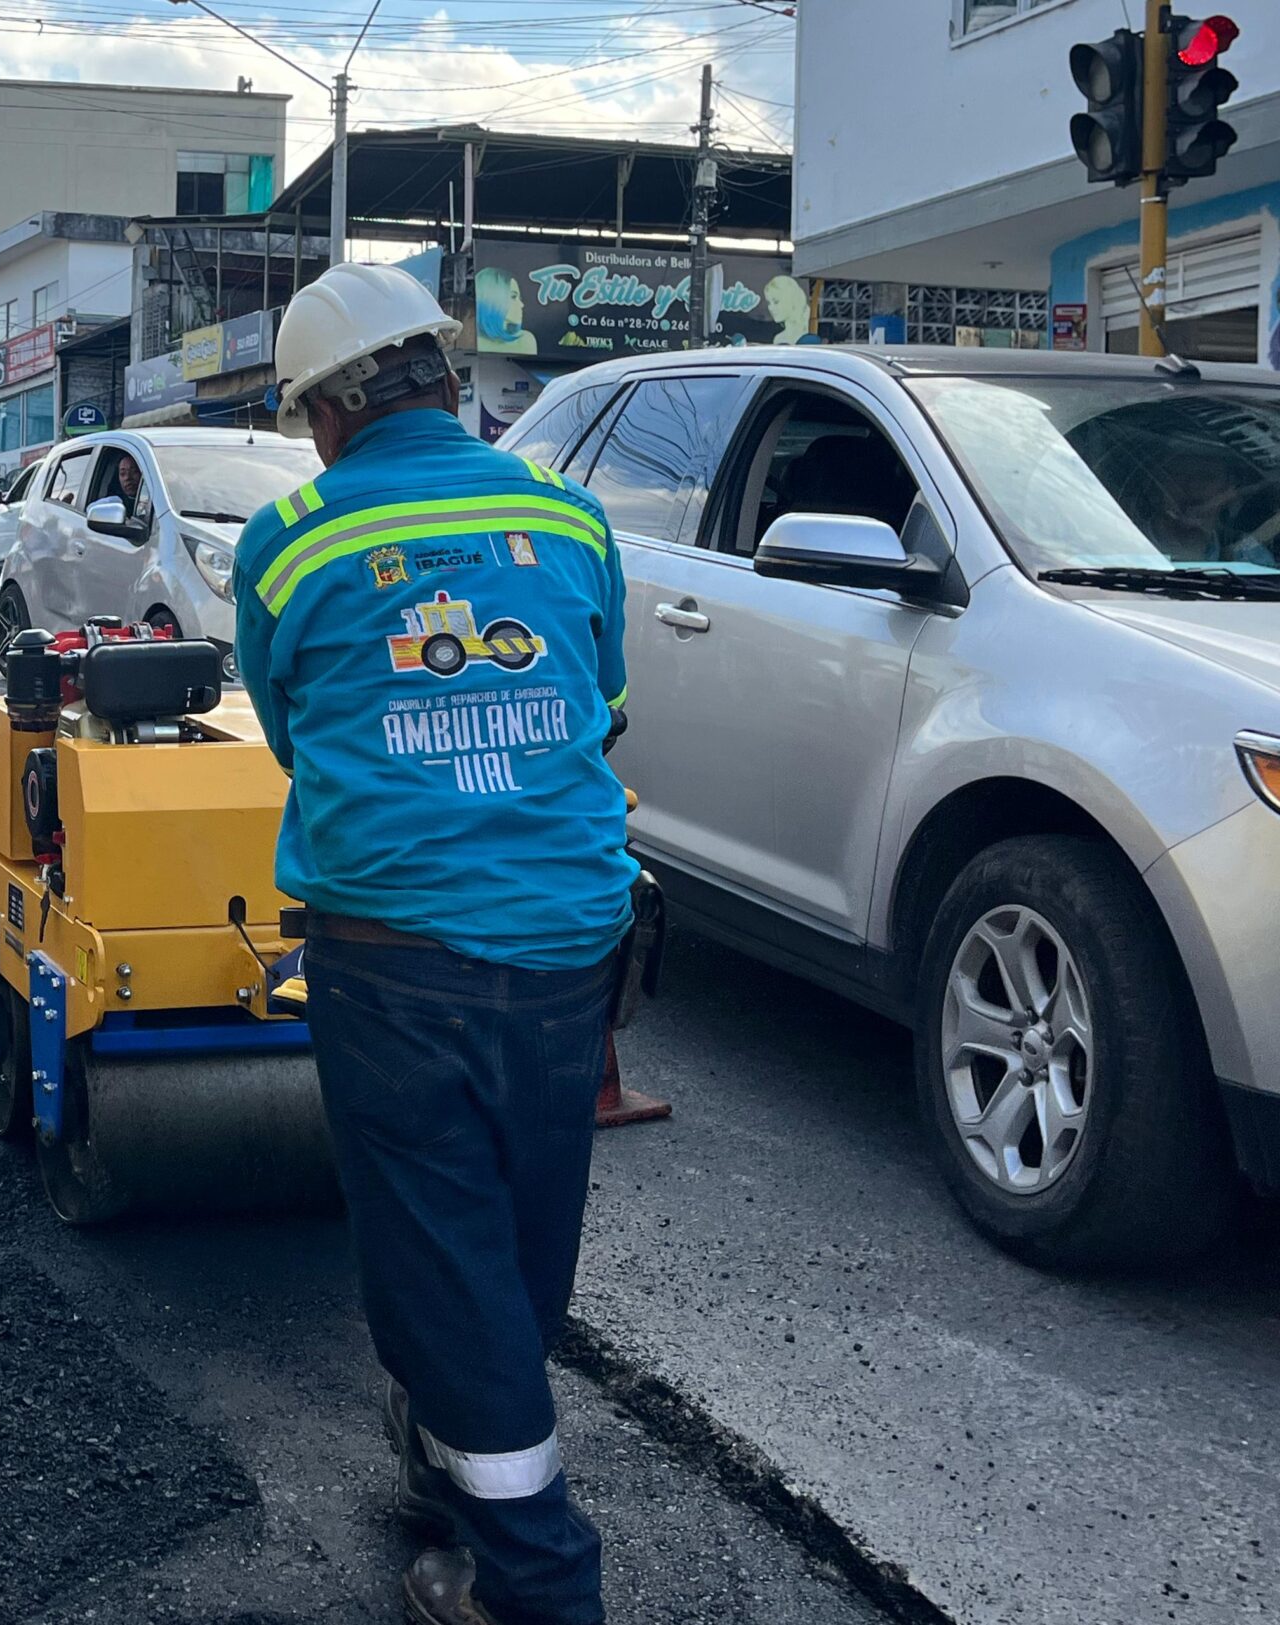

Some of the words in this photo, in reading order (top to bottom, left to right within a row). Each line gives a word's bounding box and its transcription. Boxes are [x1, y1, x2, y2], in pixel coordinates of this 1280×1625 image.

[585, 252, 652, 268] Distribuidora
[654, 257, 668, 268] de
[529, 264, 581, 305] Tu
[573, 266, 654, 308] Estilo
[581, 315, 598, 326] Cra
[600, 315, 616, 327] 6ta
[415, 550, 485, 571] IBAGUÉ
[388, 698, 431, 712] CUADRILLA
[436, 696, 446, 708] DE
[450, 690, 497, 706] REPARCHEO
[501, 689, 511, 700] DE
[514, 686, 558, 700] EMERGENCIA
[382, 699, 570, 755] AMBULANCIA
